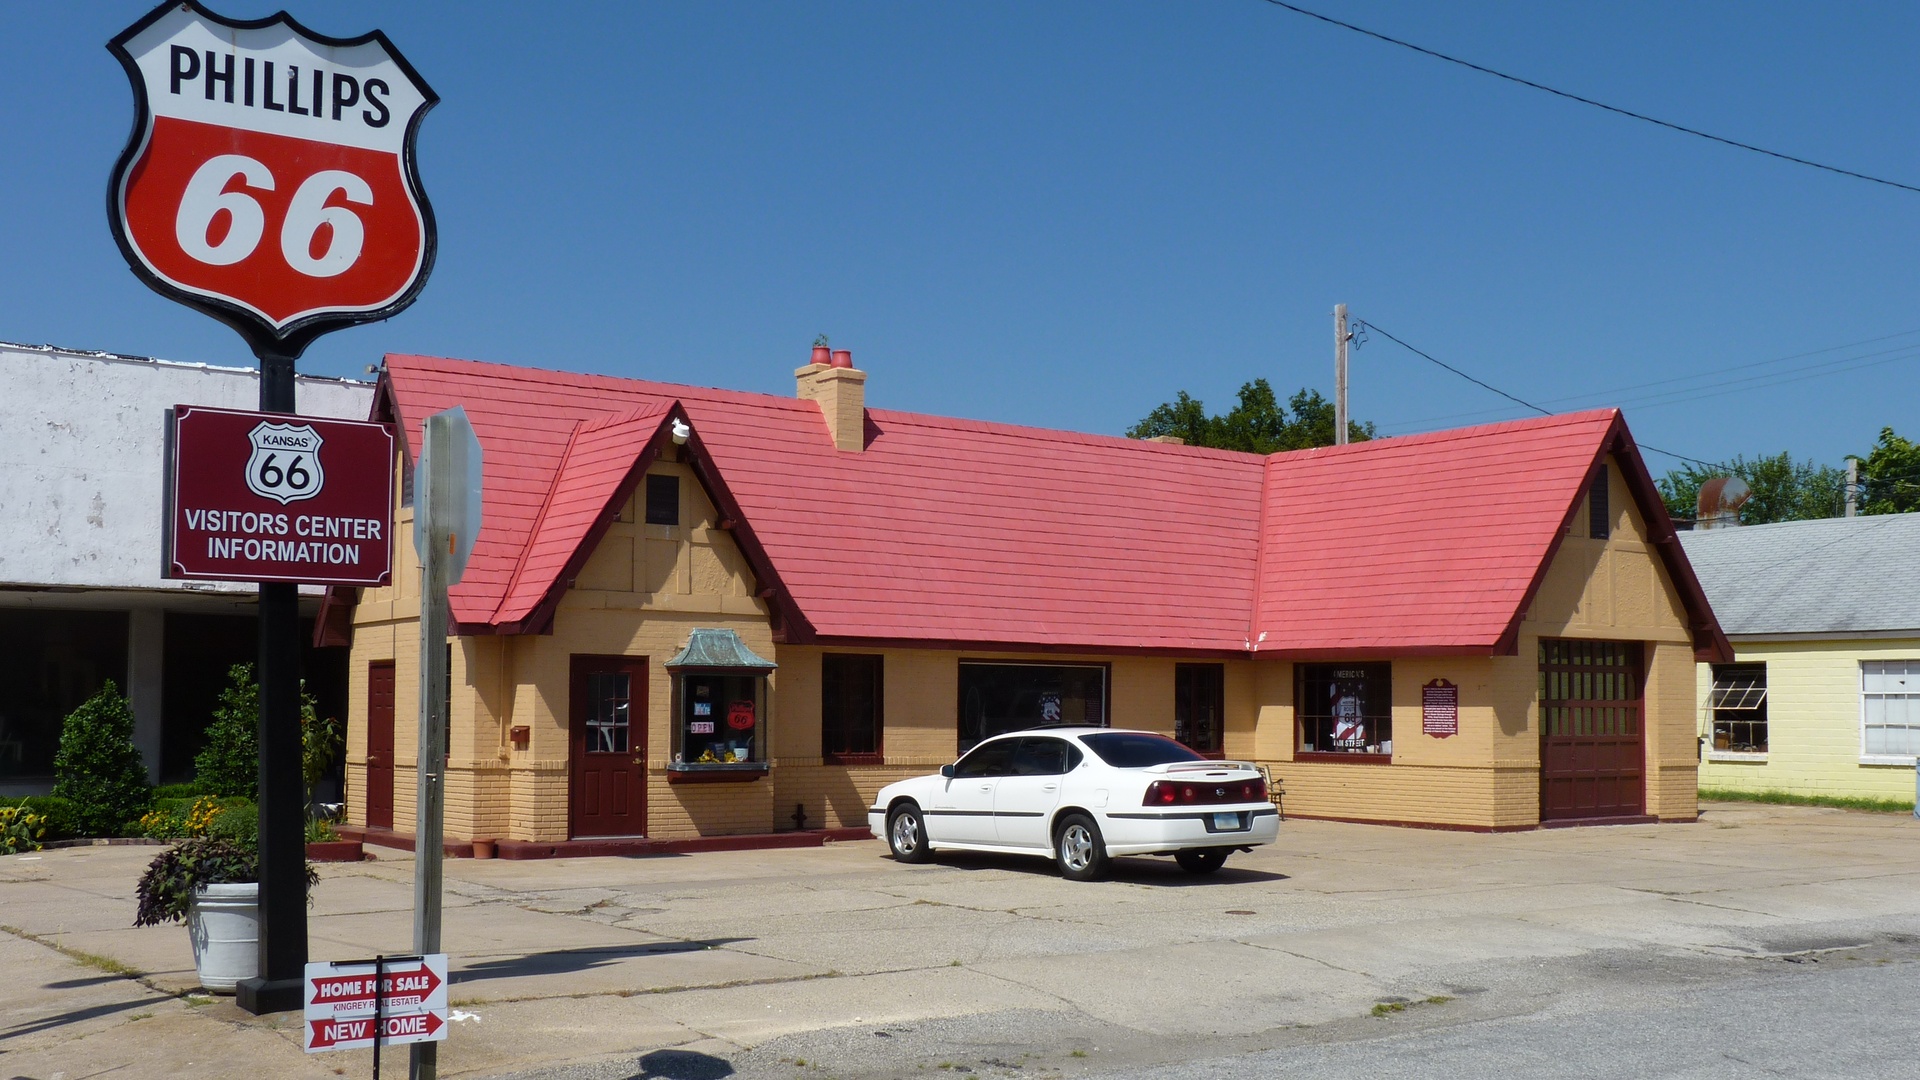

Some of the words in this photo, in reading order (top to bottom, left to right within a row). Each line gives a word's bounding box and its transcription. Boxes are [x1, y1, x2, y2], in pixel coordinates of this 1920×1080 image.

[170, 44, 390, 128] PHILLIPS
[175, 154, 374, 278] 66
[263, 434, 308, 448] KANSAS
[260, 453, 310, 490] 66
[185, 508, 289, 535] VISITORS
[295, 515, 382, 540] CENTER
[208, 537, 360, 565] INFORMATION
[692, 723, 713, 732] OPEN
[734, 714, 748, 725] 66
[320, 981, 362, 998] HOME
[396, 975, 429, 991] SALE
[333, 1001, 367, 1011] KINGREY
[369, 999, 389, 1009] RAL
[391, 997, 419, 1007] ESTATE
[324, 1022, 367, 1041] NEW
